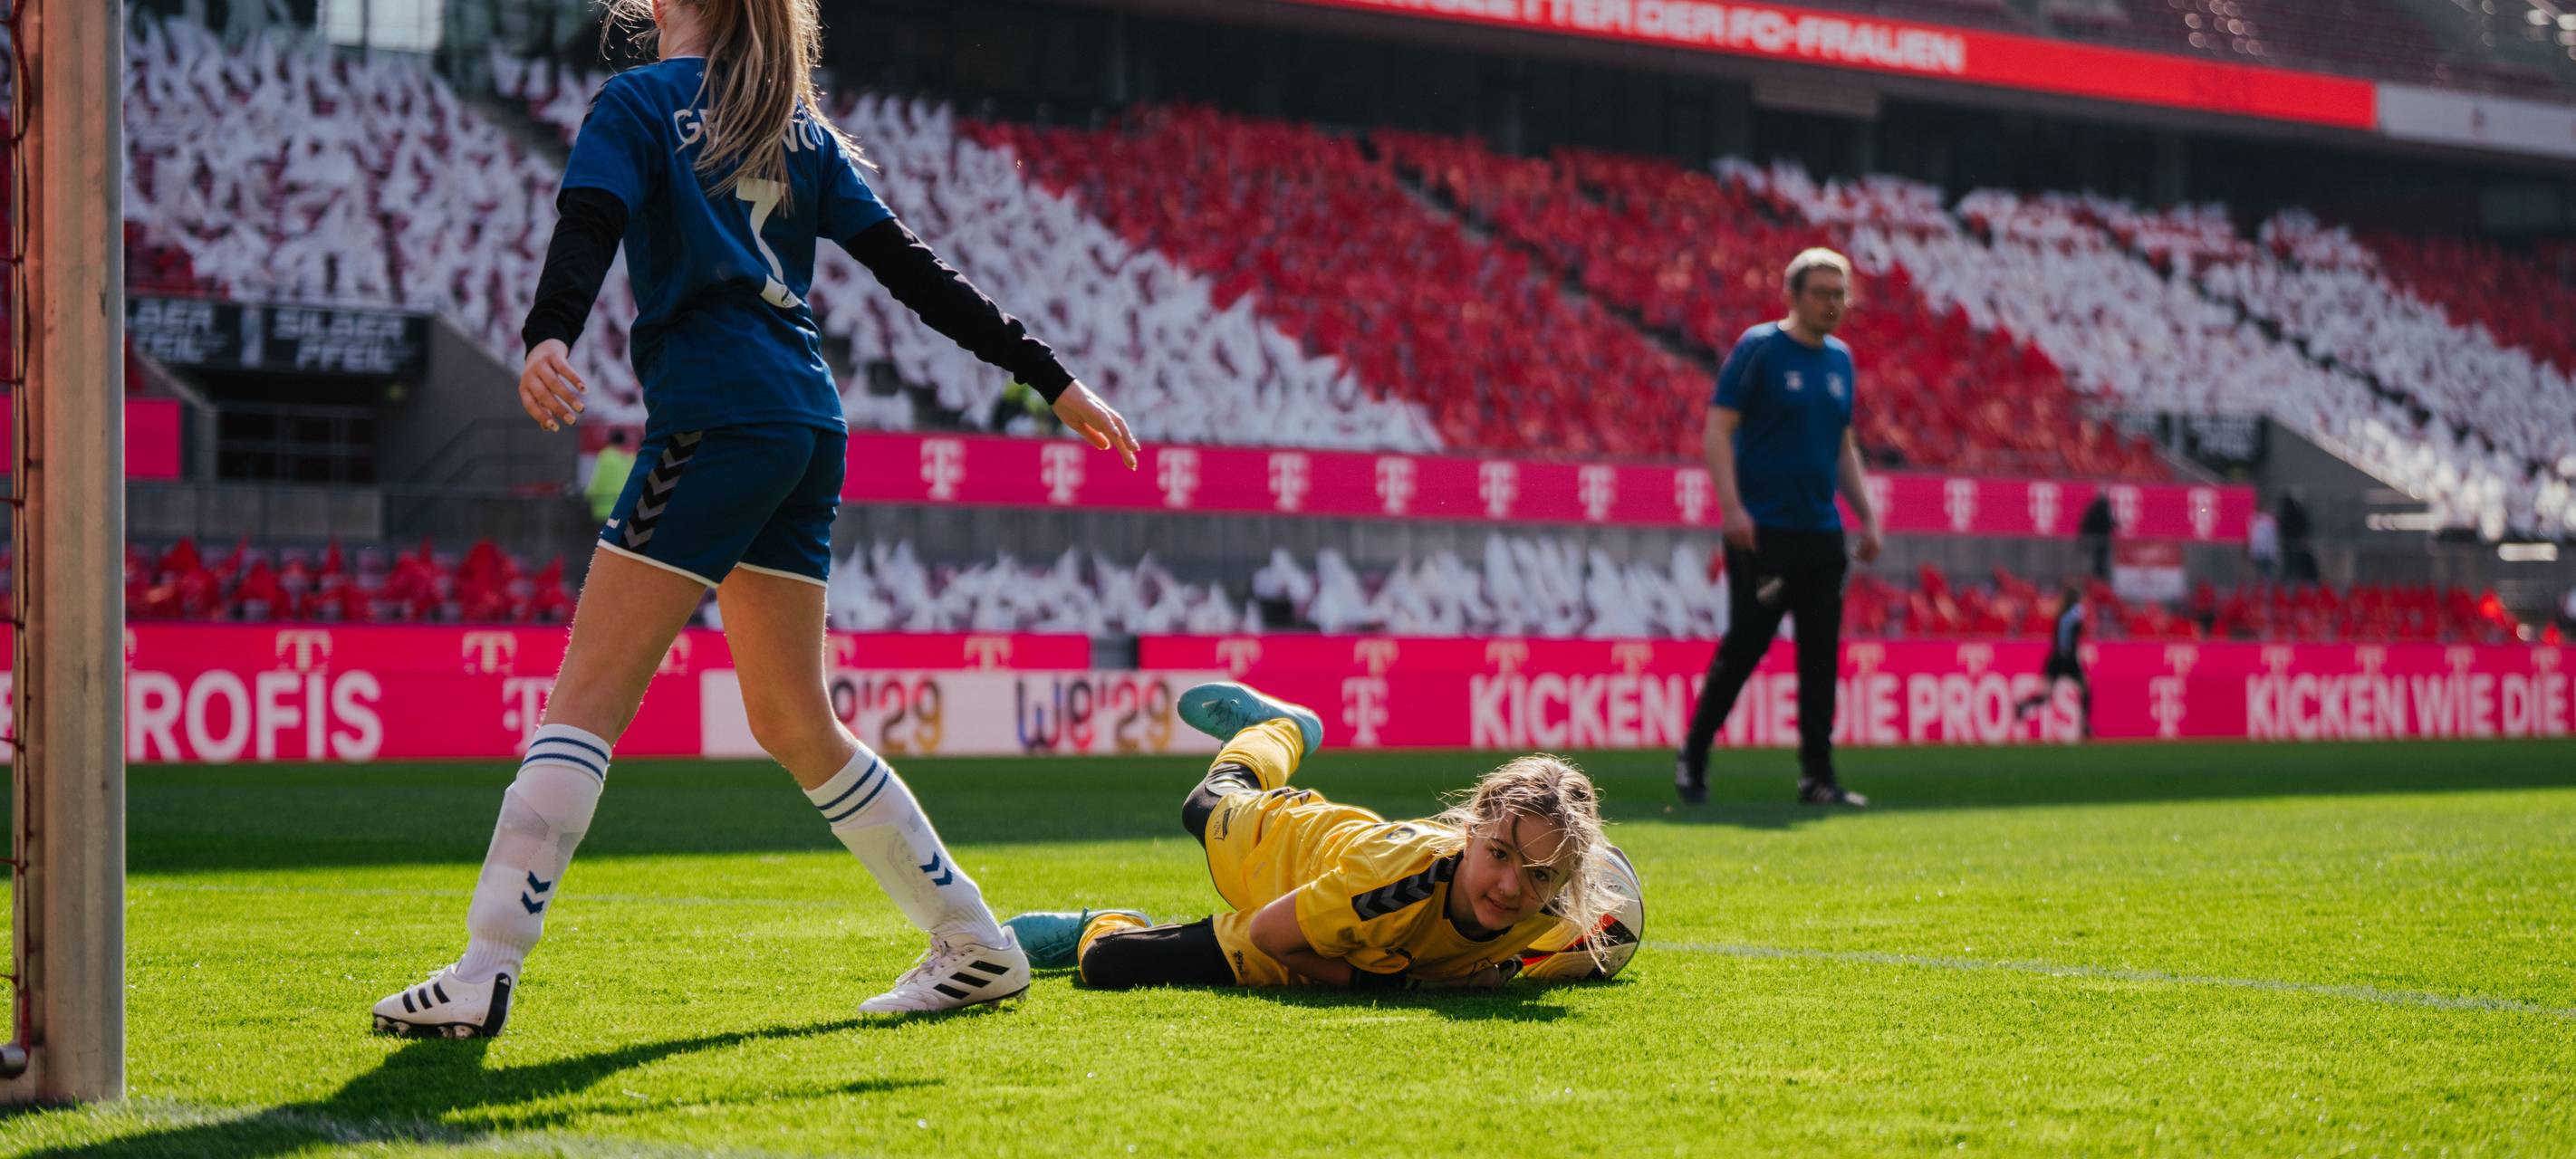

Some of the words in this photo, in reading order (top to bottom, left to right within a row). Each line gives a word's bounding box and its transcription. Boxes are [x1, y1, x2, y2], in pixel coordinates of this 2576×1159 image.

[1726, 6, 1967, 75] FC-FRAUEN
[125, 298, 215, 334] BER
[128, 668, 384, 763] ROFIS
[831, 676, 943, 752] e'29
[1468, 673, 1687, 749] KICKEN
[2244, 672, 2408, 742] KICKEN
[2410, 673, 2496, 740] WIE
[2500, 673, 2570, 739] DIE
